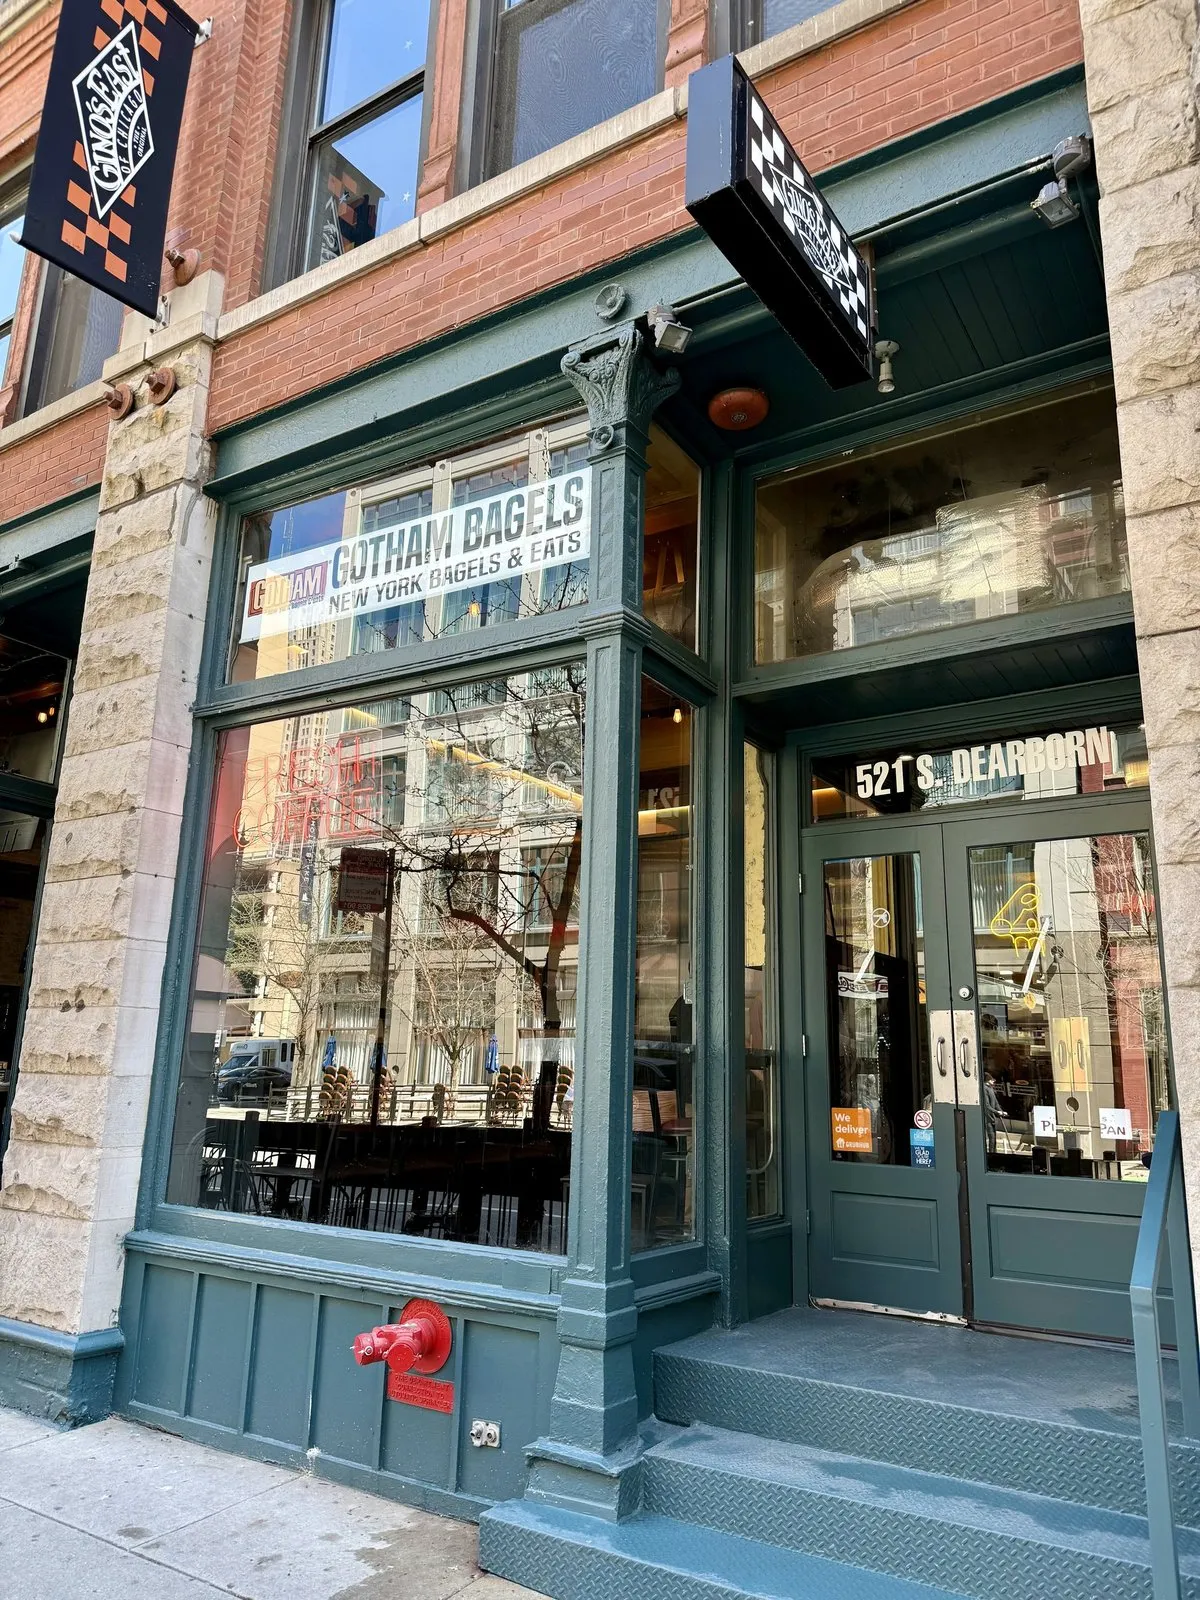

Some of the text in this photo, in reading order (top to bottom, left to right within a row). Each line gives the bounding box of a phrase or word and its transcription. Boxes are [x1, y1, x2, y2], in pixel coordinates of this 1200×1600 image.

[86, 42, 140, 192] GINO'S EAST
[117, 89, 143, 174] OF CHICAGO
[137, 127, 147, 158] ORIGINAL
[331, 476, 584, 589] GOTHAM BAGELS
[329, 586, 369, 615] NEW
[376, 573, 422, 604] YORK
[429, 552, 500, 589] BAGELS
[507, 547, 522, 569] &
[530, 531, 581, 563] EATS
[856, 726, 1110, 799] 521 S. DEARBORN
[834, 1113, 851, 1122] We
[835, 1124, 869, 1135] deliver
